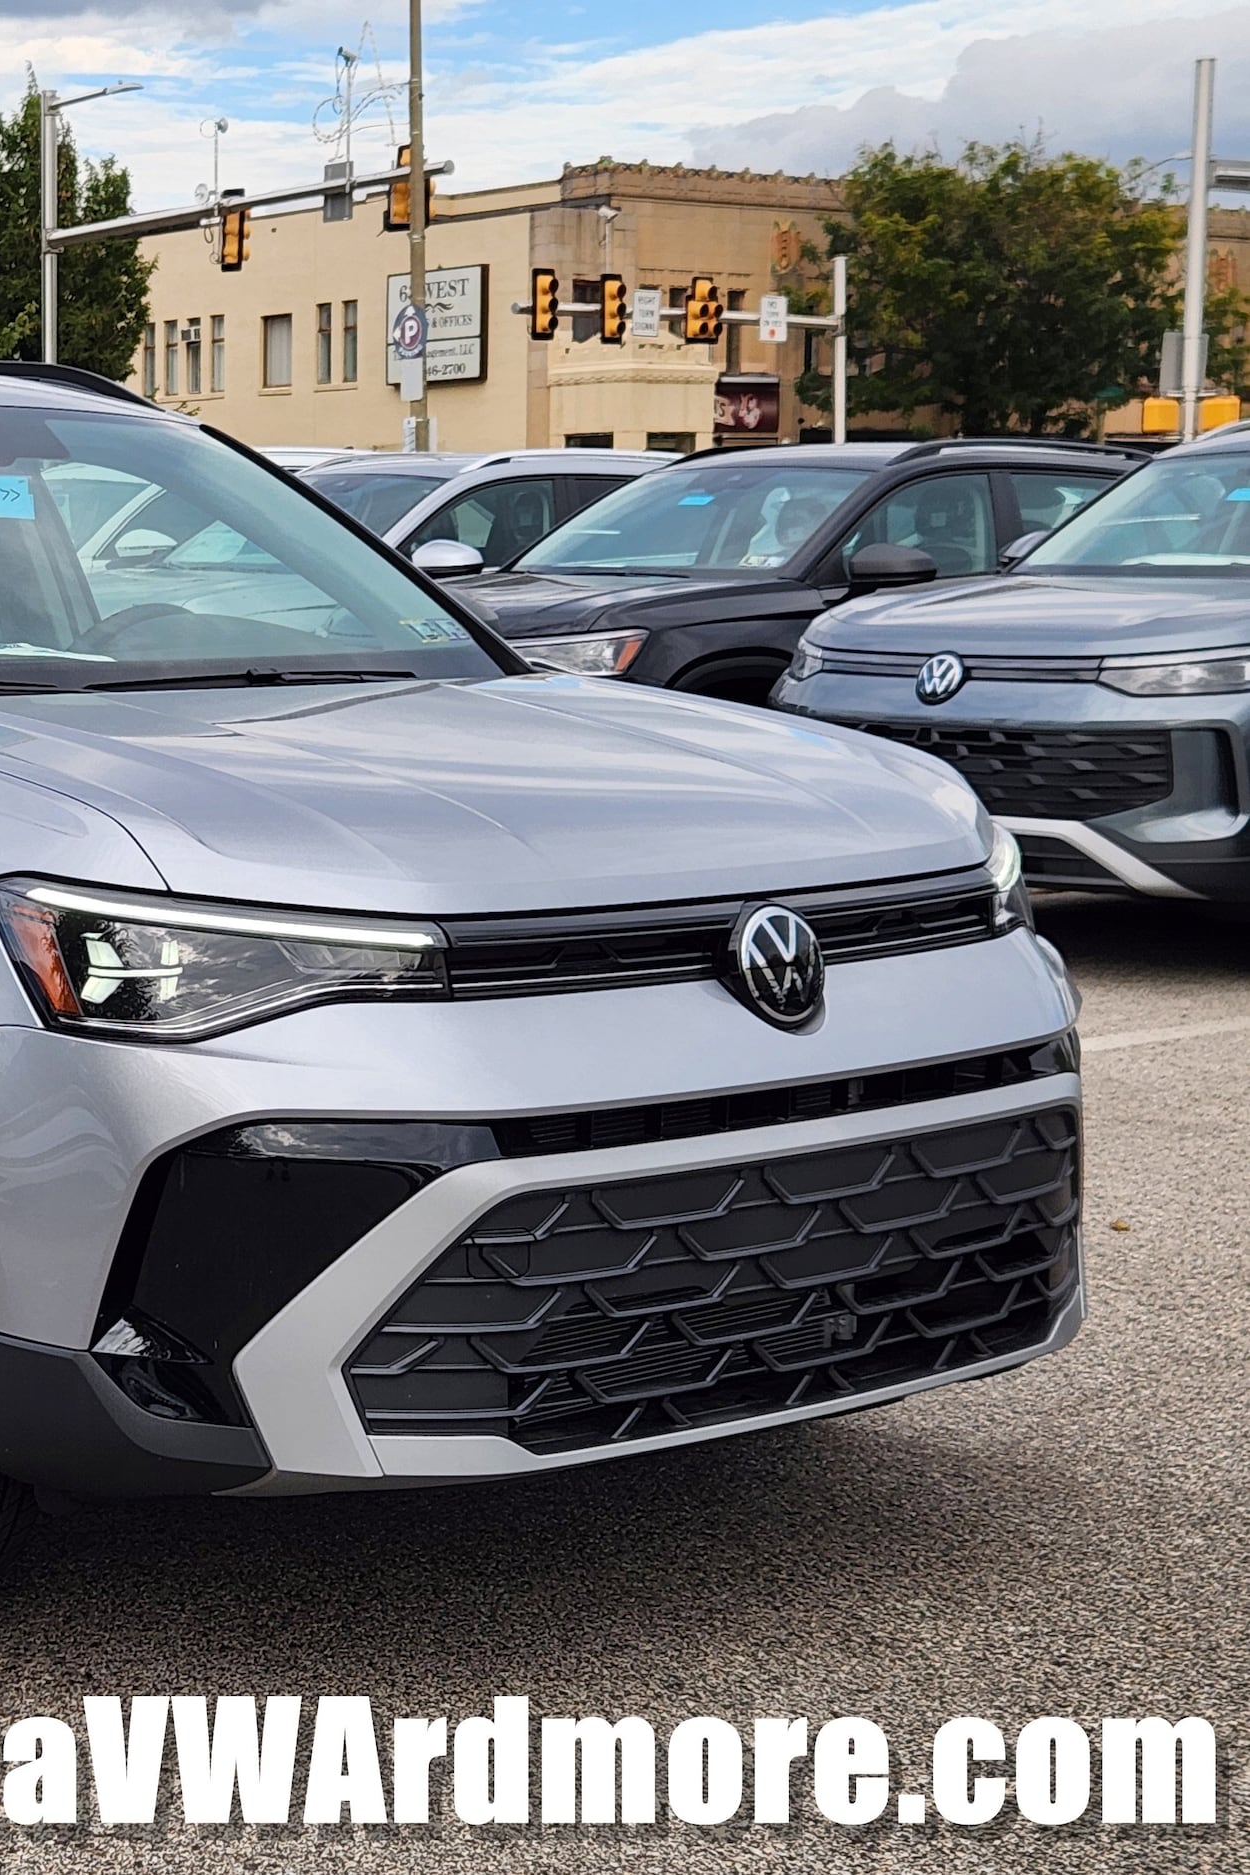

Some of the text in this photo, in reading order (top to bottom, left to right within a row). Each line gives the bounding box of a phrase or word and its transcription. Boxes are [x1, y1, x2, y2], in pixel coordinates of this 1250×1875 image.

[399, 285, 412, 303] 6
[439, 314, 473, 327] OFFICES
[404, 319, 418, 344] P
[459, 343, 475, 355] LLC
